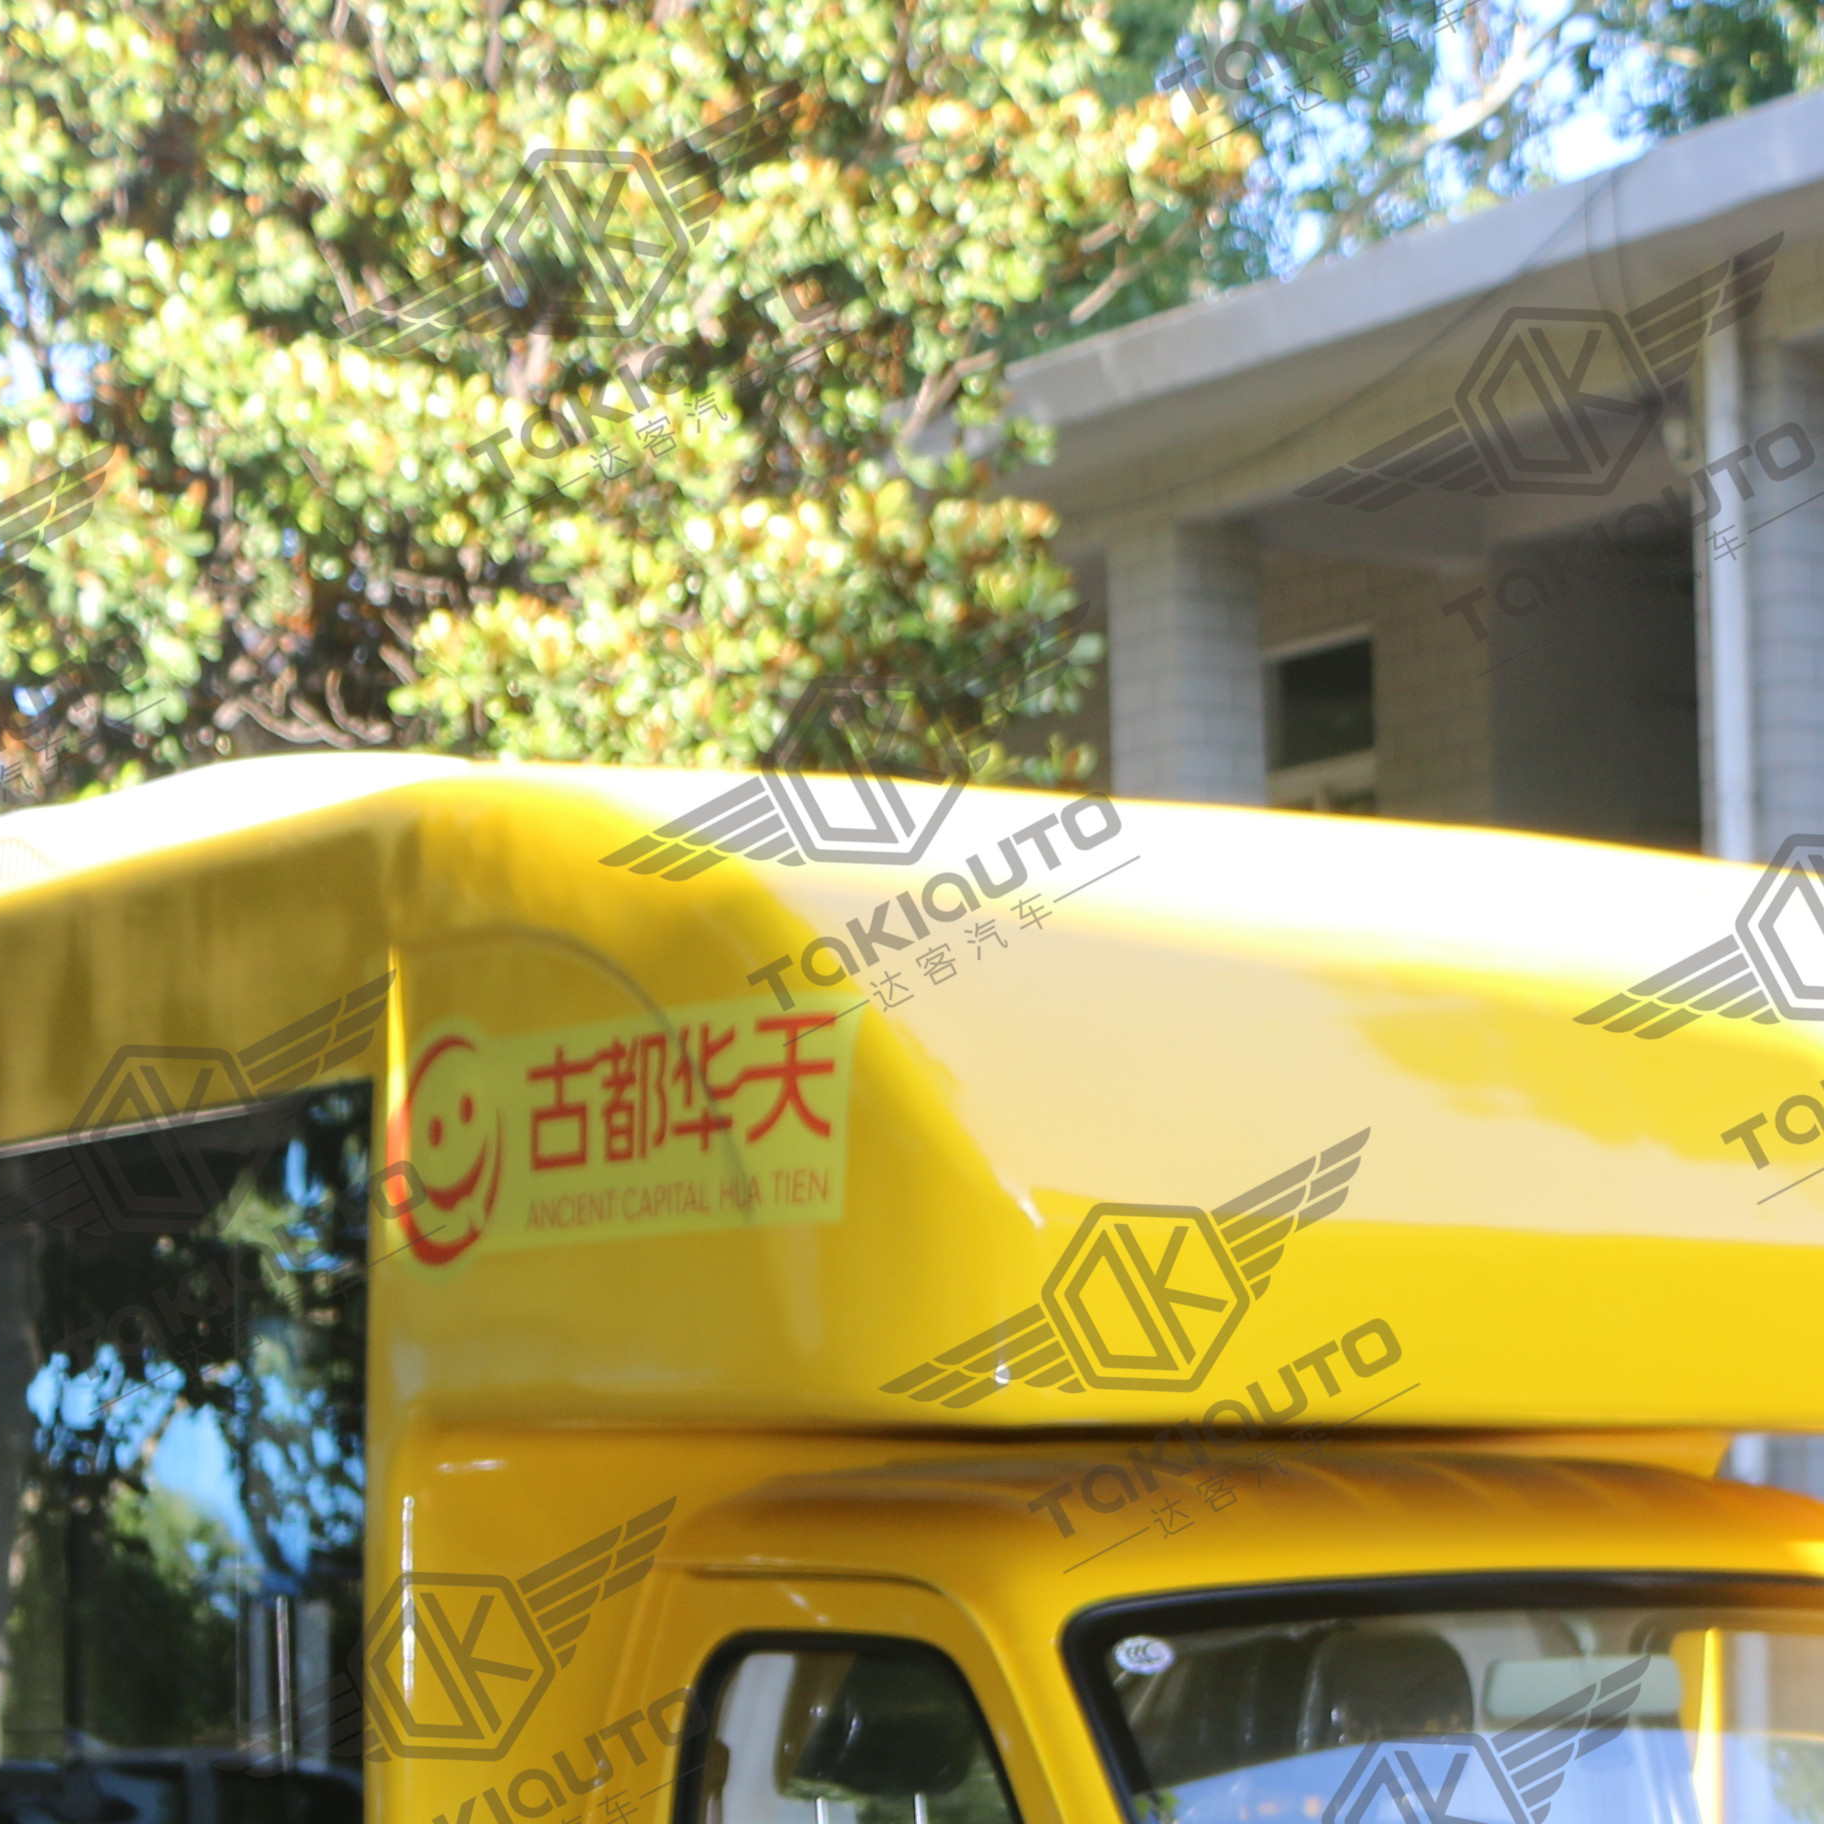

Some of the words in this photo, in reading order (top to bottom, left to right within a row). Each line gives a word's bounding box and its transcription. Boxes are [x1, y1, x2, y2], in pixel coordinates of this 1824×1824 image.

[526, 1010, 837, 1171] 古都华天
[528, 1188, 616, 1230] ANCIENT
[622, 1180, 711, 1223] CAPITAL
[719, 1174, 763, 1210] HUA
[771, 1166, 831, 1204] TIEN
